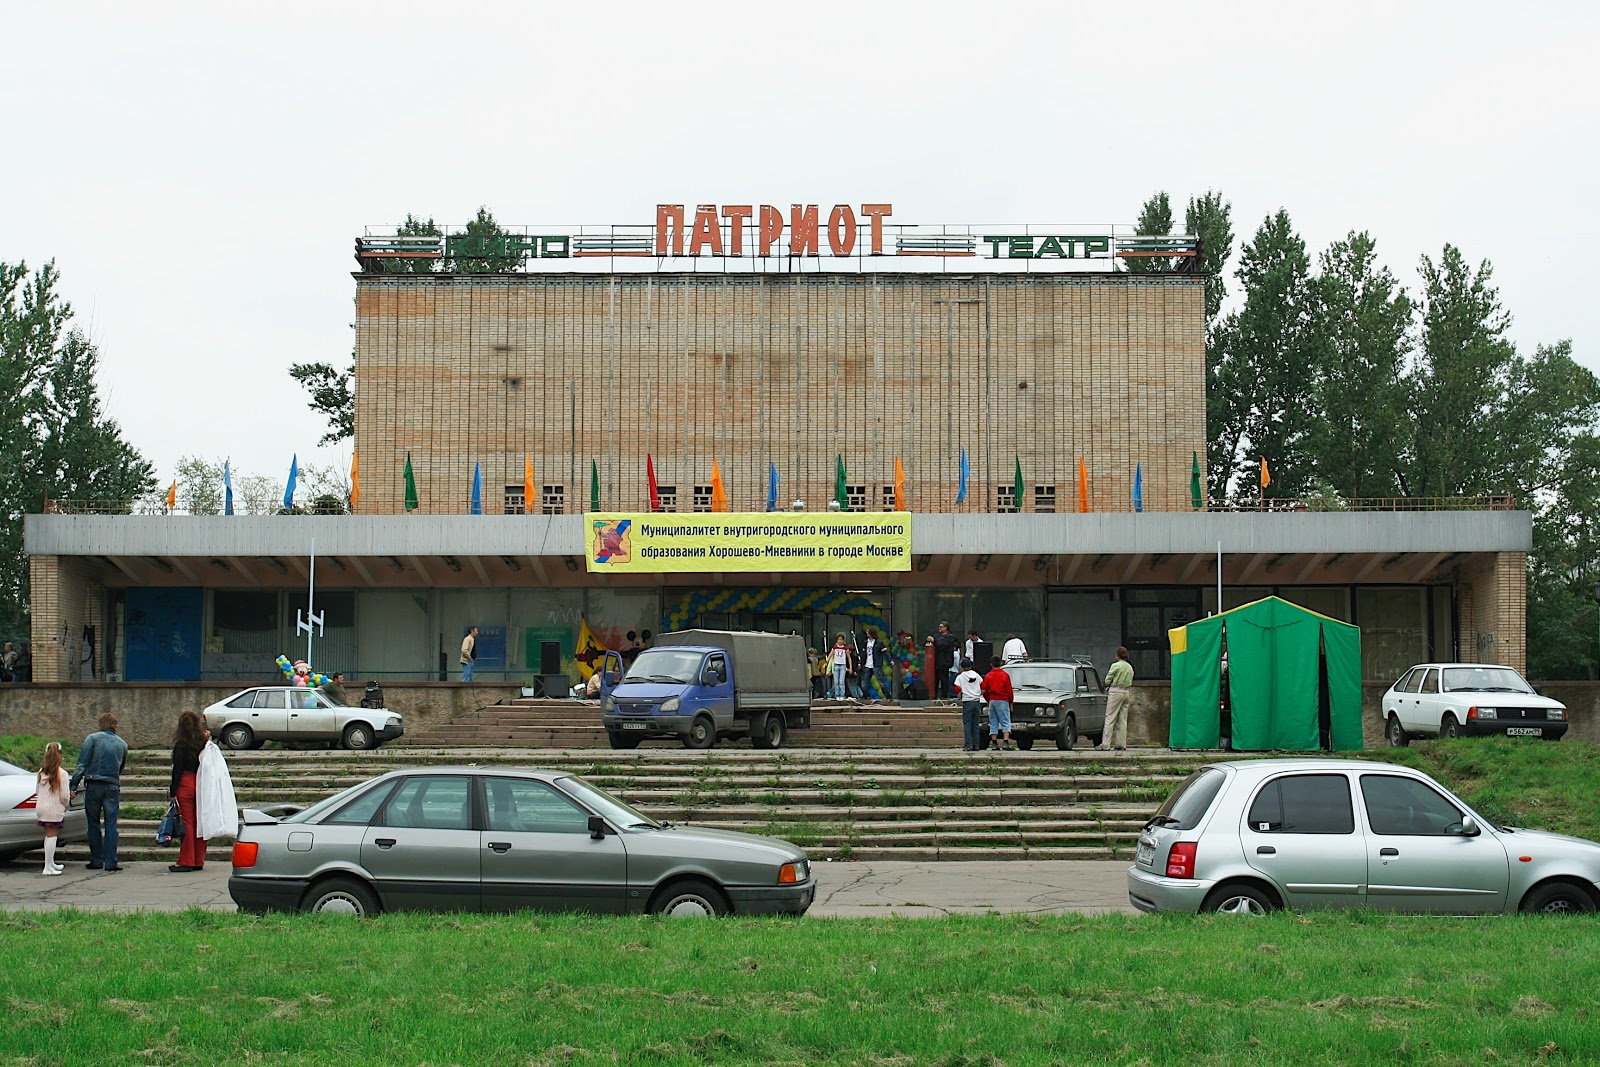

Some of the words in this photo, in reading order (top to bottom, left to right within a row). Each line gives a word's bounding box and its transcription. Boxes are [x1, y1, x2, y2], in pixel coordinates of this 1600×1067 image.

[445, 235, 570, 258] КИНО
[655, 204, 893, 258] ПАТРИОТ
[983, 235, 1109, 259] ТЕАТР
[641, 524, 721, 537] Муниципалитет
[723, 525, 816, 537] внутригородского
[819, 525, 904, 537] муниципального
[641, 545, 706, 559] образования
[709, 545, 816, 559] Хорошево-Мневники
[818, 547, 825, 557] в
[828, 546, 863, 559] городе
[866, 545, 904, 557] Москве
